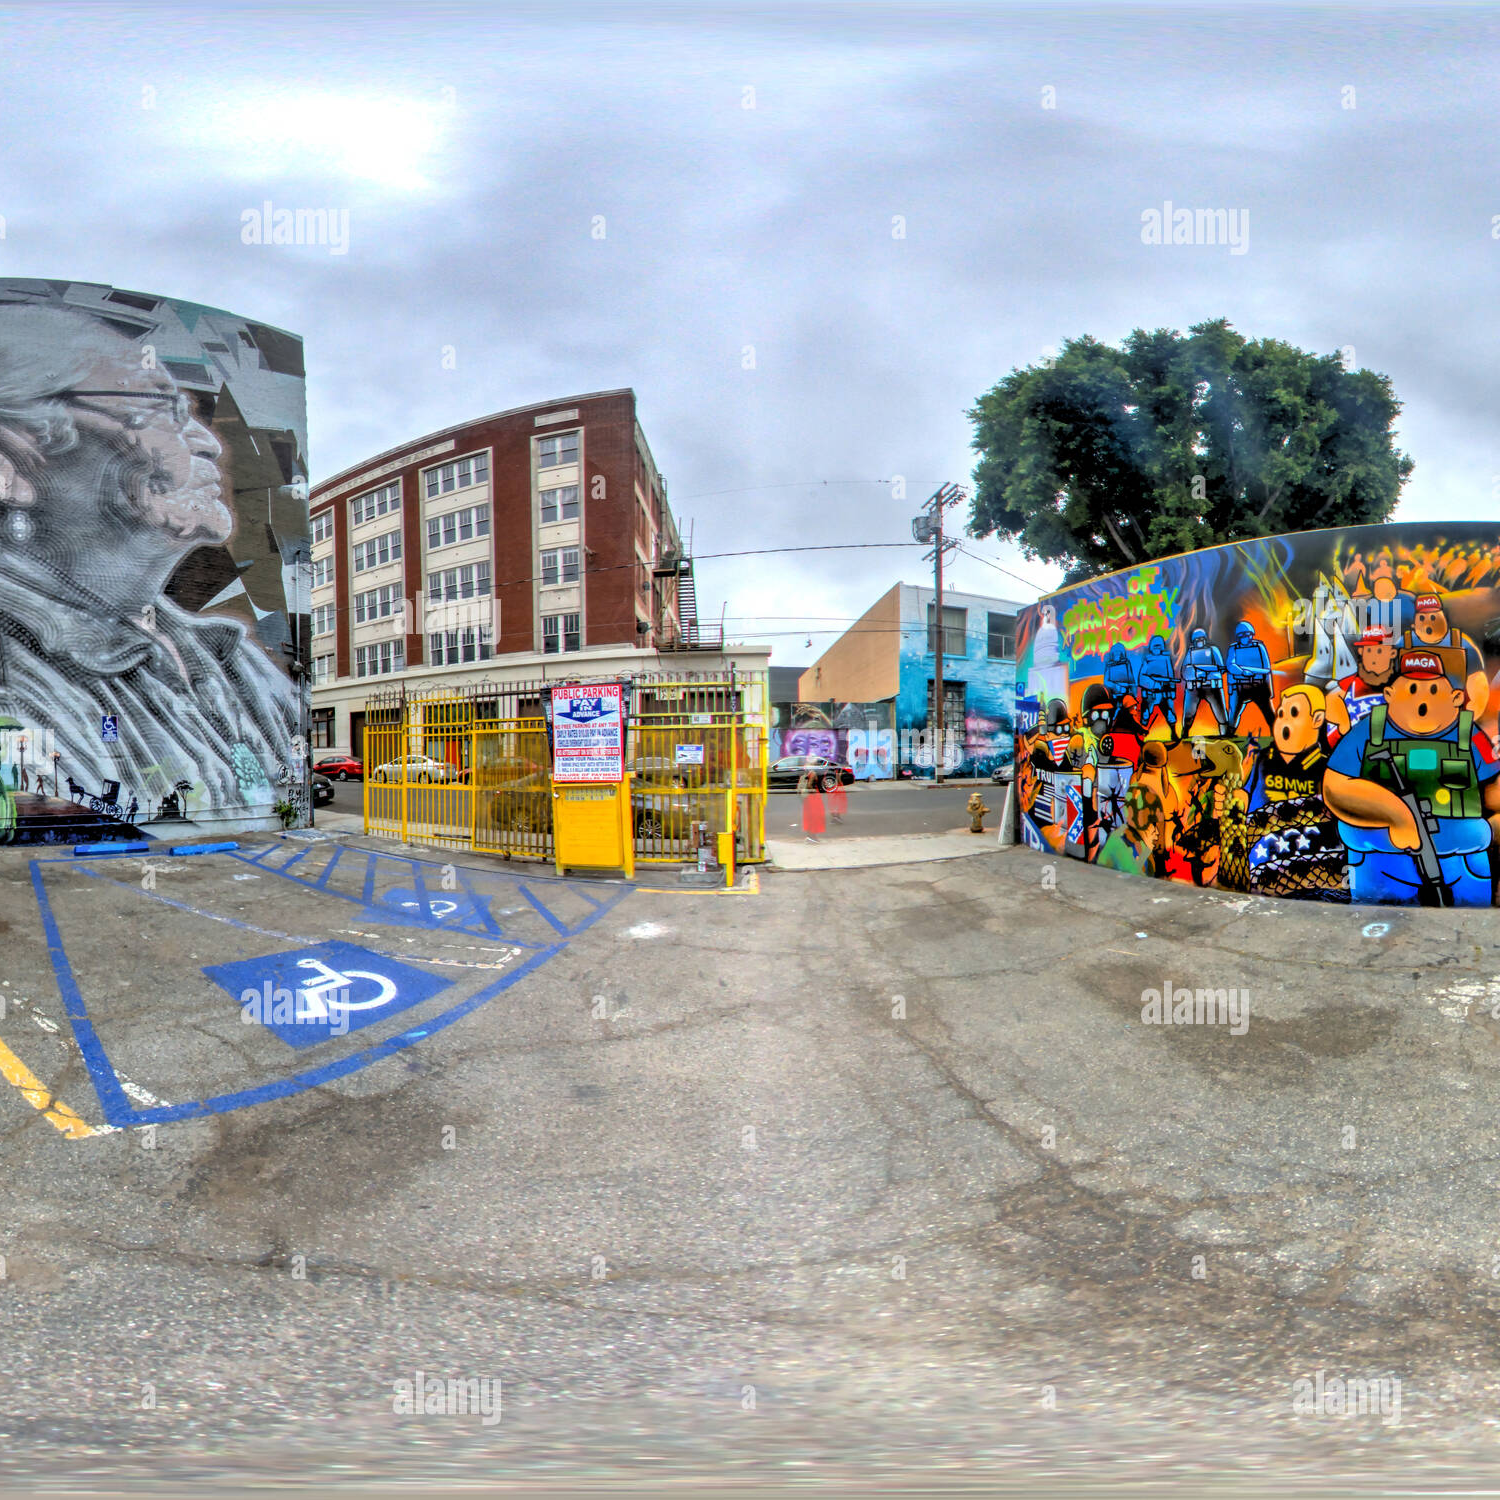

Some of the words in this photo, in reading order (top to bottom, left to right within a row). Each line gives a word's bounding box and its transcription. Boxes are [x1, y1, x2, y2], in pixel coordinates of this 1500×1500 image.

[1417, 598, 1437, 606] MAGA
[1405, 657, 1436, 668] MAGA
[553, 688, 580, 700] PUBLIC
[582, 686, 618, 698] PARKING
[572, 698, 599, 707] PAY
[572, 710, 601, 718] ADVANCE
